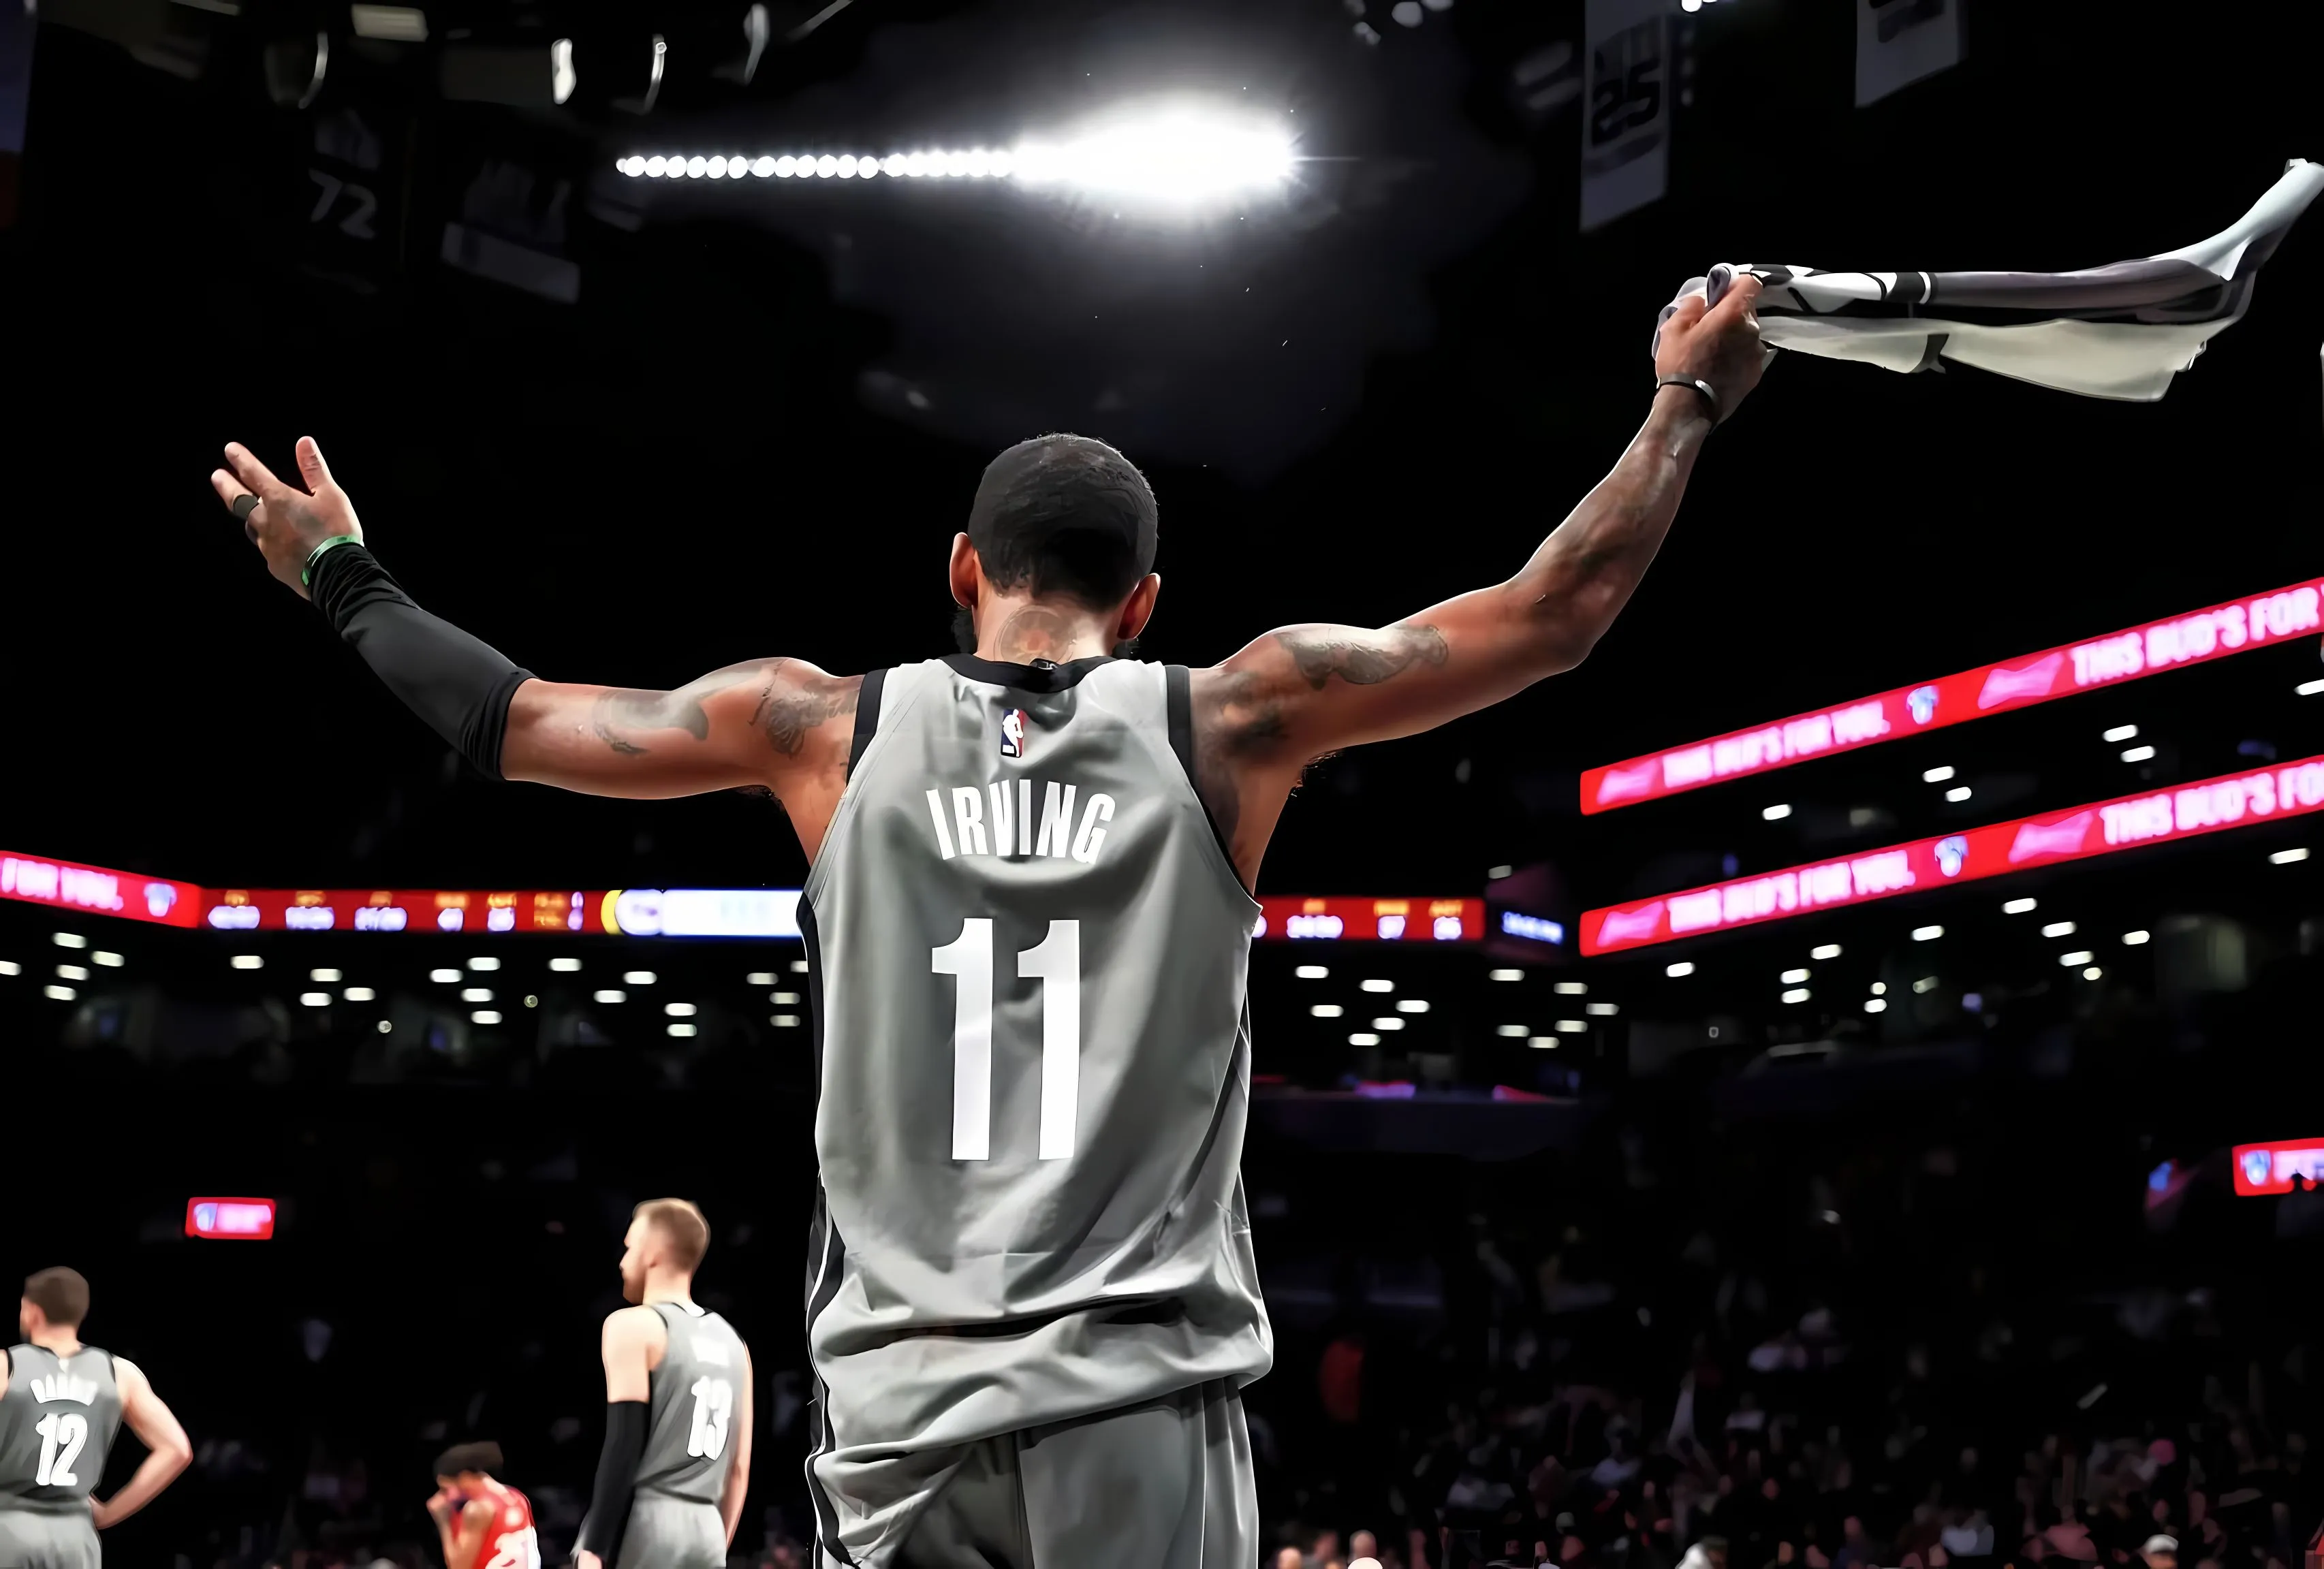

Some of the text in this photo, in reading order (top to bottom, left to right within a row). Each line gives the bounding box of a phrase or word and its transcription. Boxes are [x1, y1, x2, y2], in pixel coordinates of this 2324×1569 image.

[2070, 632, 2144, 685] THIS
[2249, 587, 2320, 641] FOR
[925, 778, 1116, 865] IRVING
[2099, 794, 2173, 844] THIS
[931, 917, 1080, 1160] 11
[35, 1412, 88, 1486] 12
